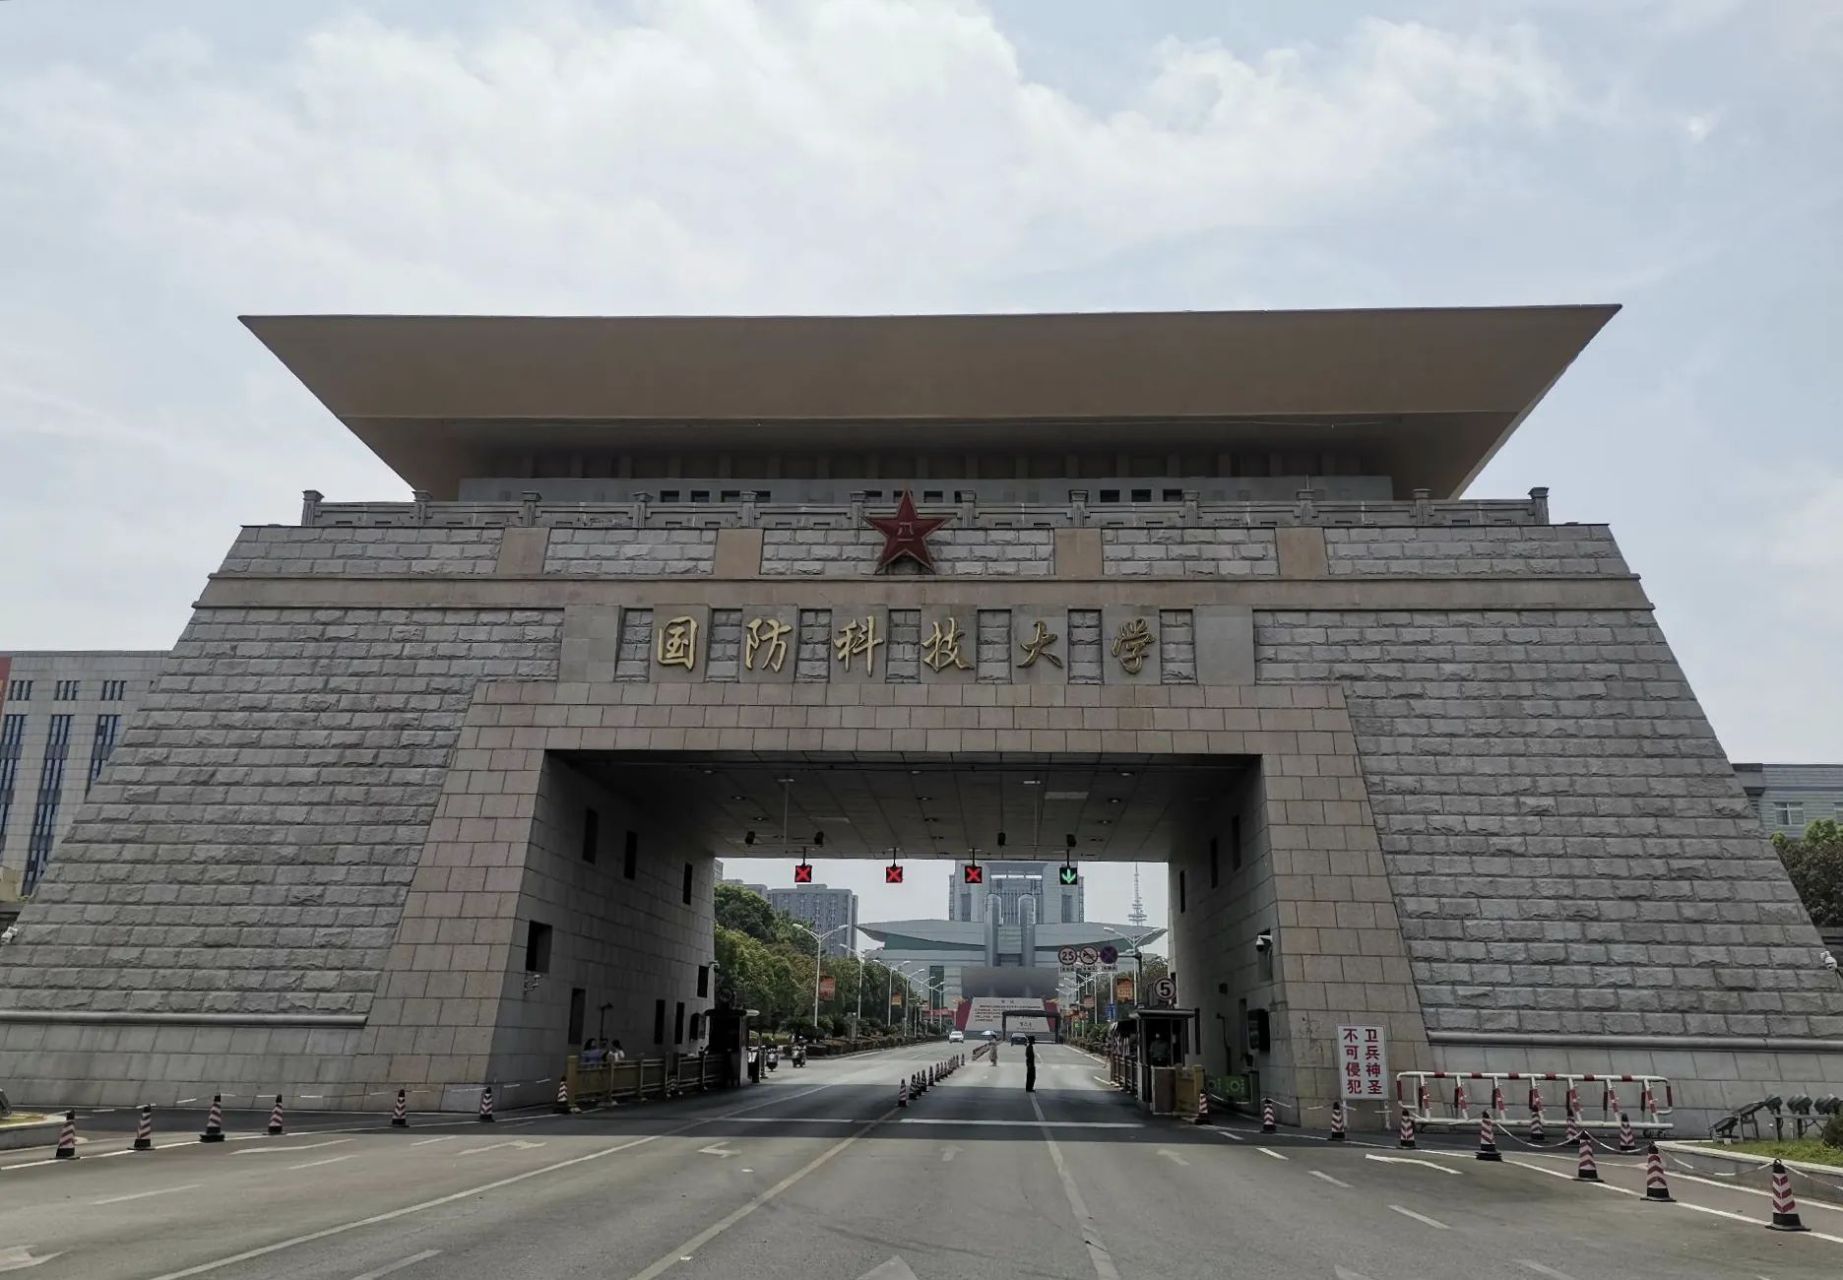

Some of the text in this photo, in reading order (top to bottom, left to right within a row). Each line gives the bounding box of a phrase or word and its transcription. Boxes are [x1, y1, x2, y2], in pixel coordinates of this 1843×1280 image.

[656, 615, 1156, 677] 国防科技大学
[1062, 951, 1074, 961] 25
[1159, 982, 1171, 996] 5
[1343, 1028, 1362, 1095] 不可侵犯
[1364, 1028, 1383, 1095] 卫兵神圣
